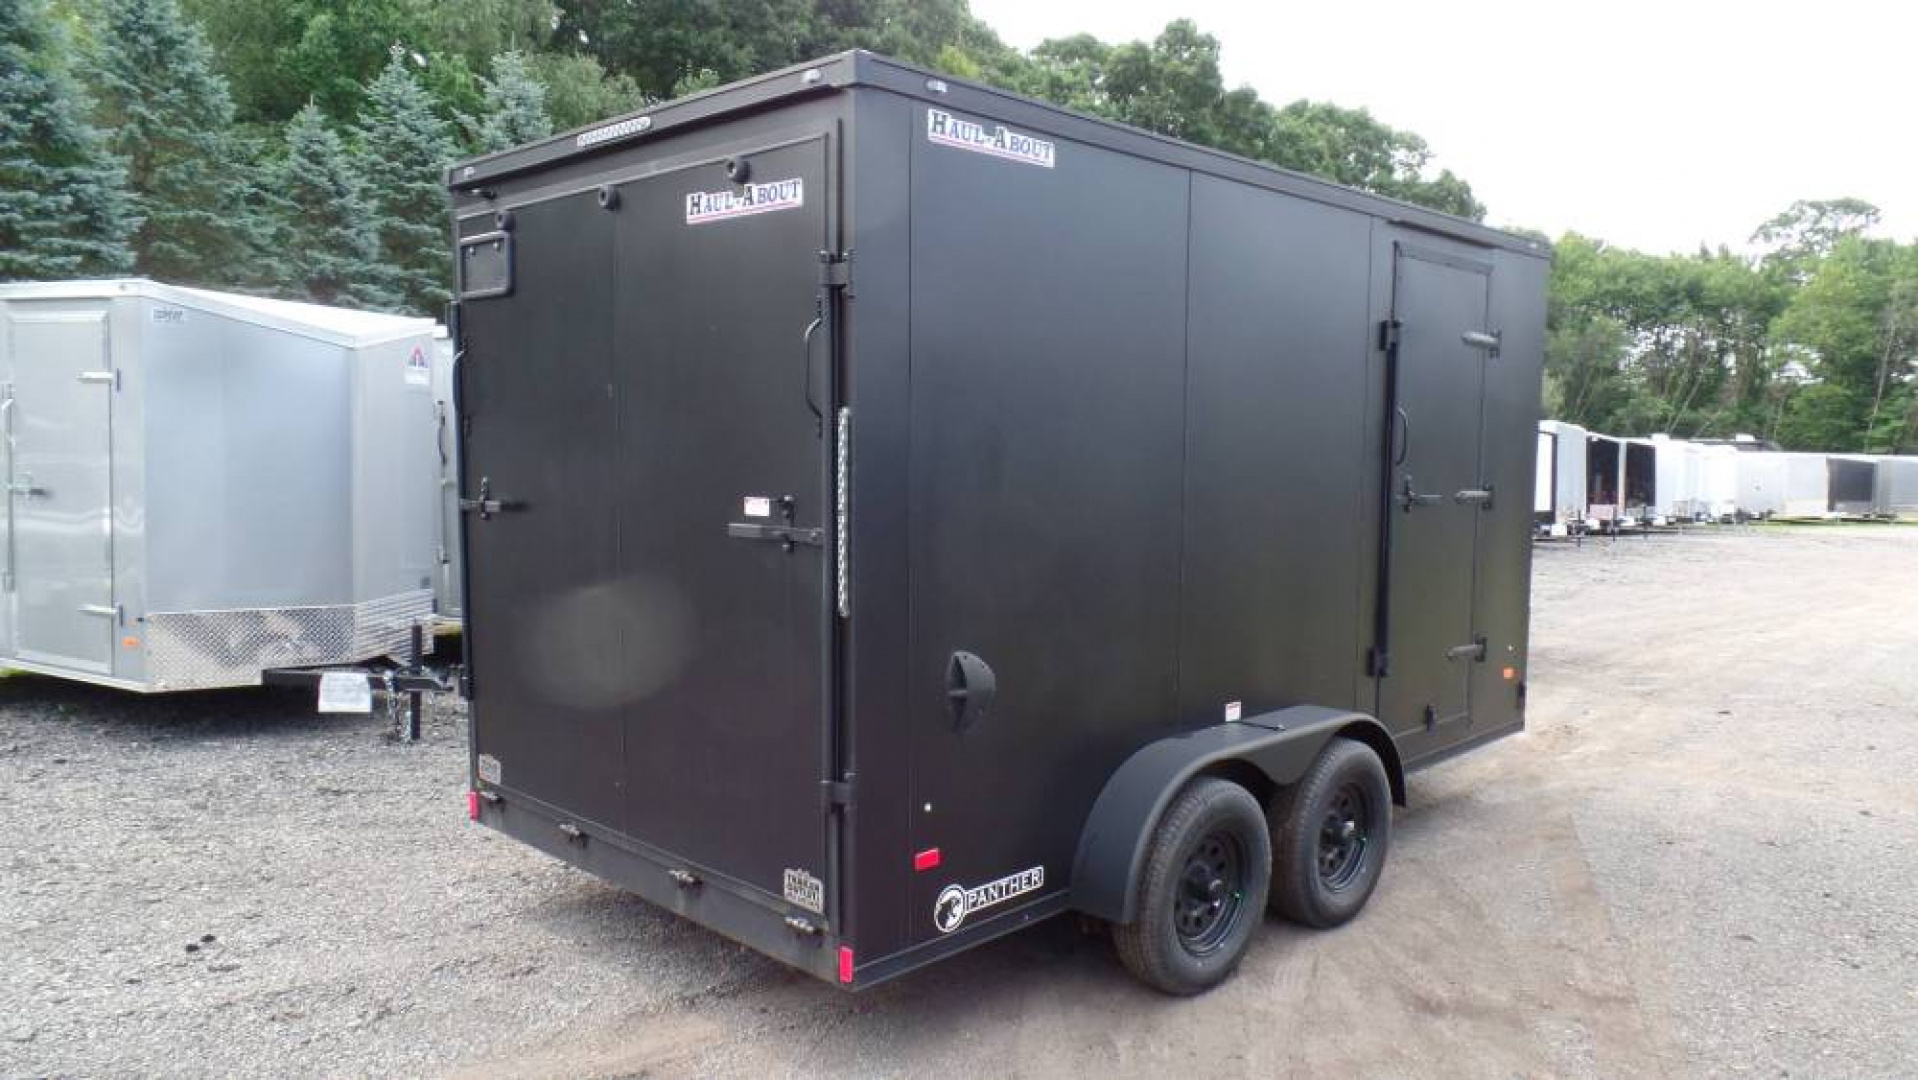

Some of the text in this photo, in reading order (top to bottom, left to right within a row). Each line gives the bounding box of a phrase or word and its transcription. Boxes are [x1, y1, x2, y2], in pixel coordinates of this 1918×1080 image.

[932, 112, 1051, 159] HAUL-ABOUT
[690, 181, 801, 215] HAUL-ABOUT
[967, 867, 1043, 908] PANTHER
